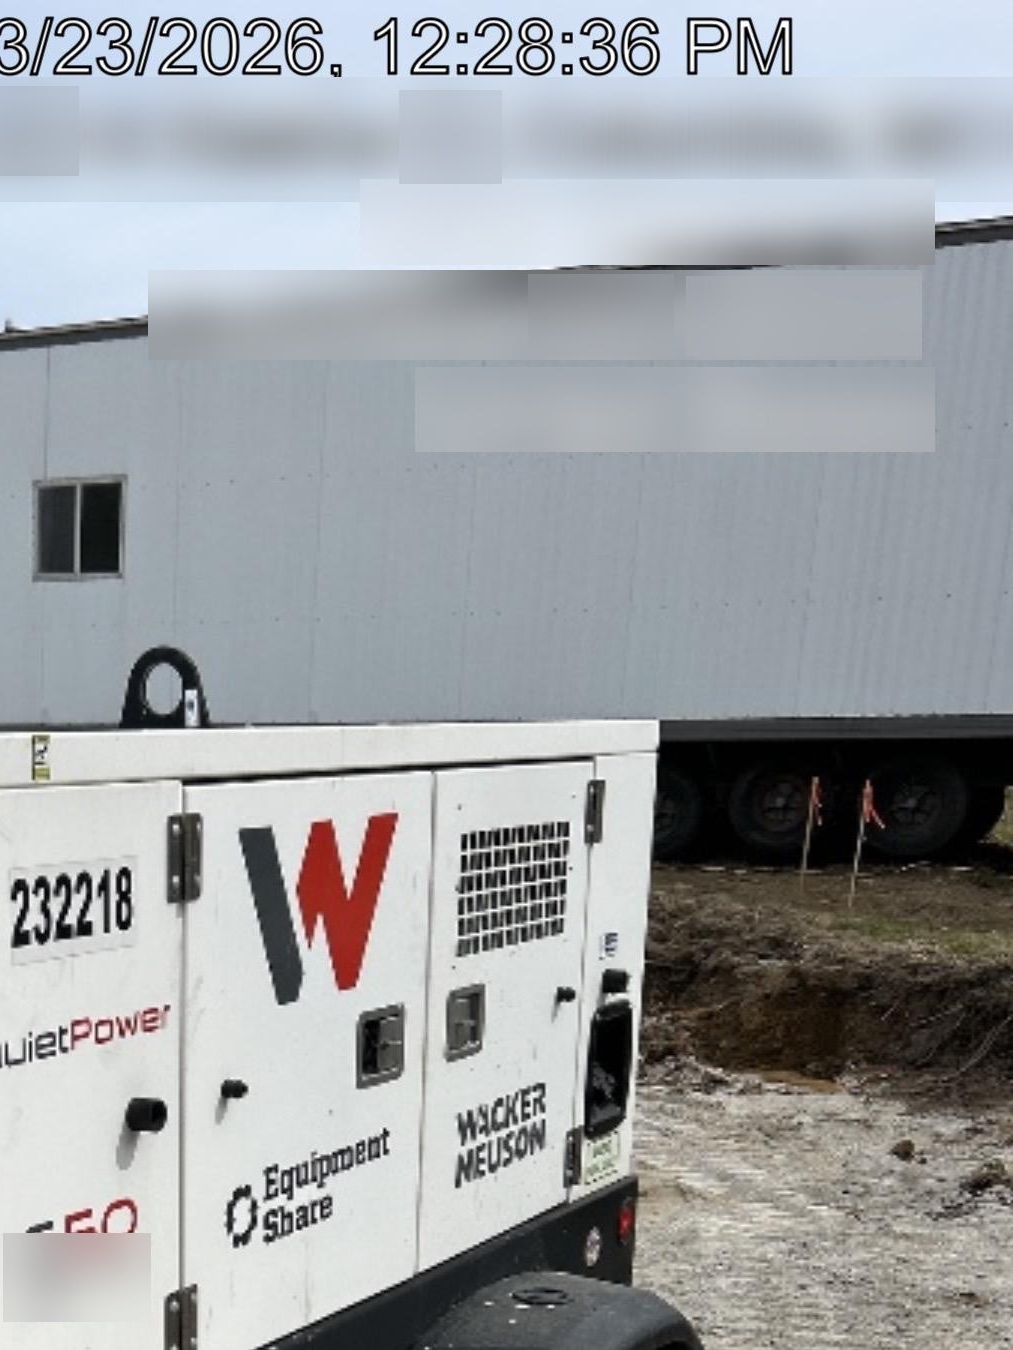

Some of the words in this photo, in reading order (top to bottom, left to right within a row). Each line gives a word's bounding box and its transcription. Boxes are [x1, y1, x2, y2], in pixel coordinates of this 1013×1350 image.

[10, 866, 132, 948] 232218
[456, 1082, 546, 1146] WACKER
[263, 1127, 390, 1201] Equipment
[454, 1118, 546, 1189] NEUSON
[262, 1195, 333, 1243] Share
